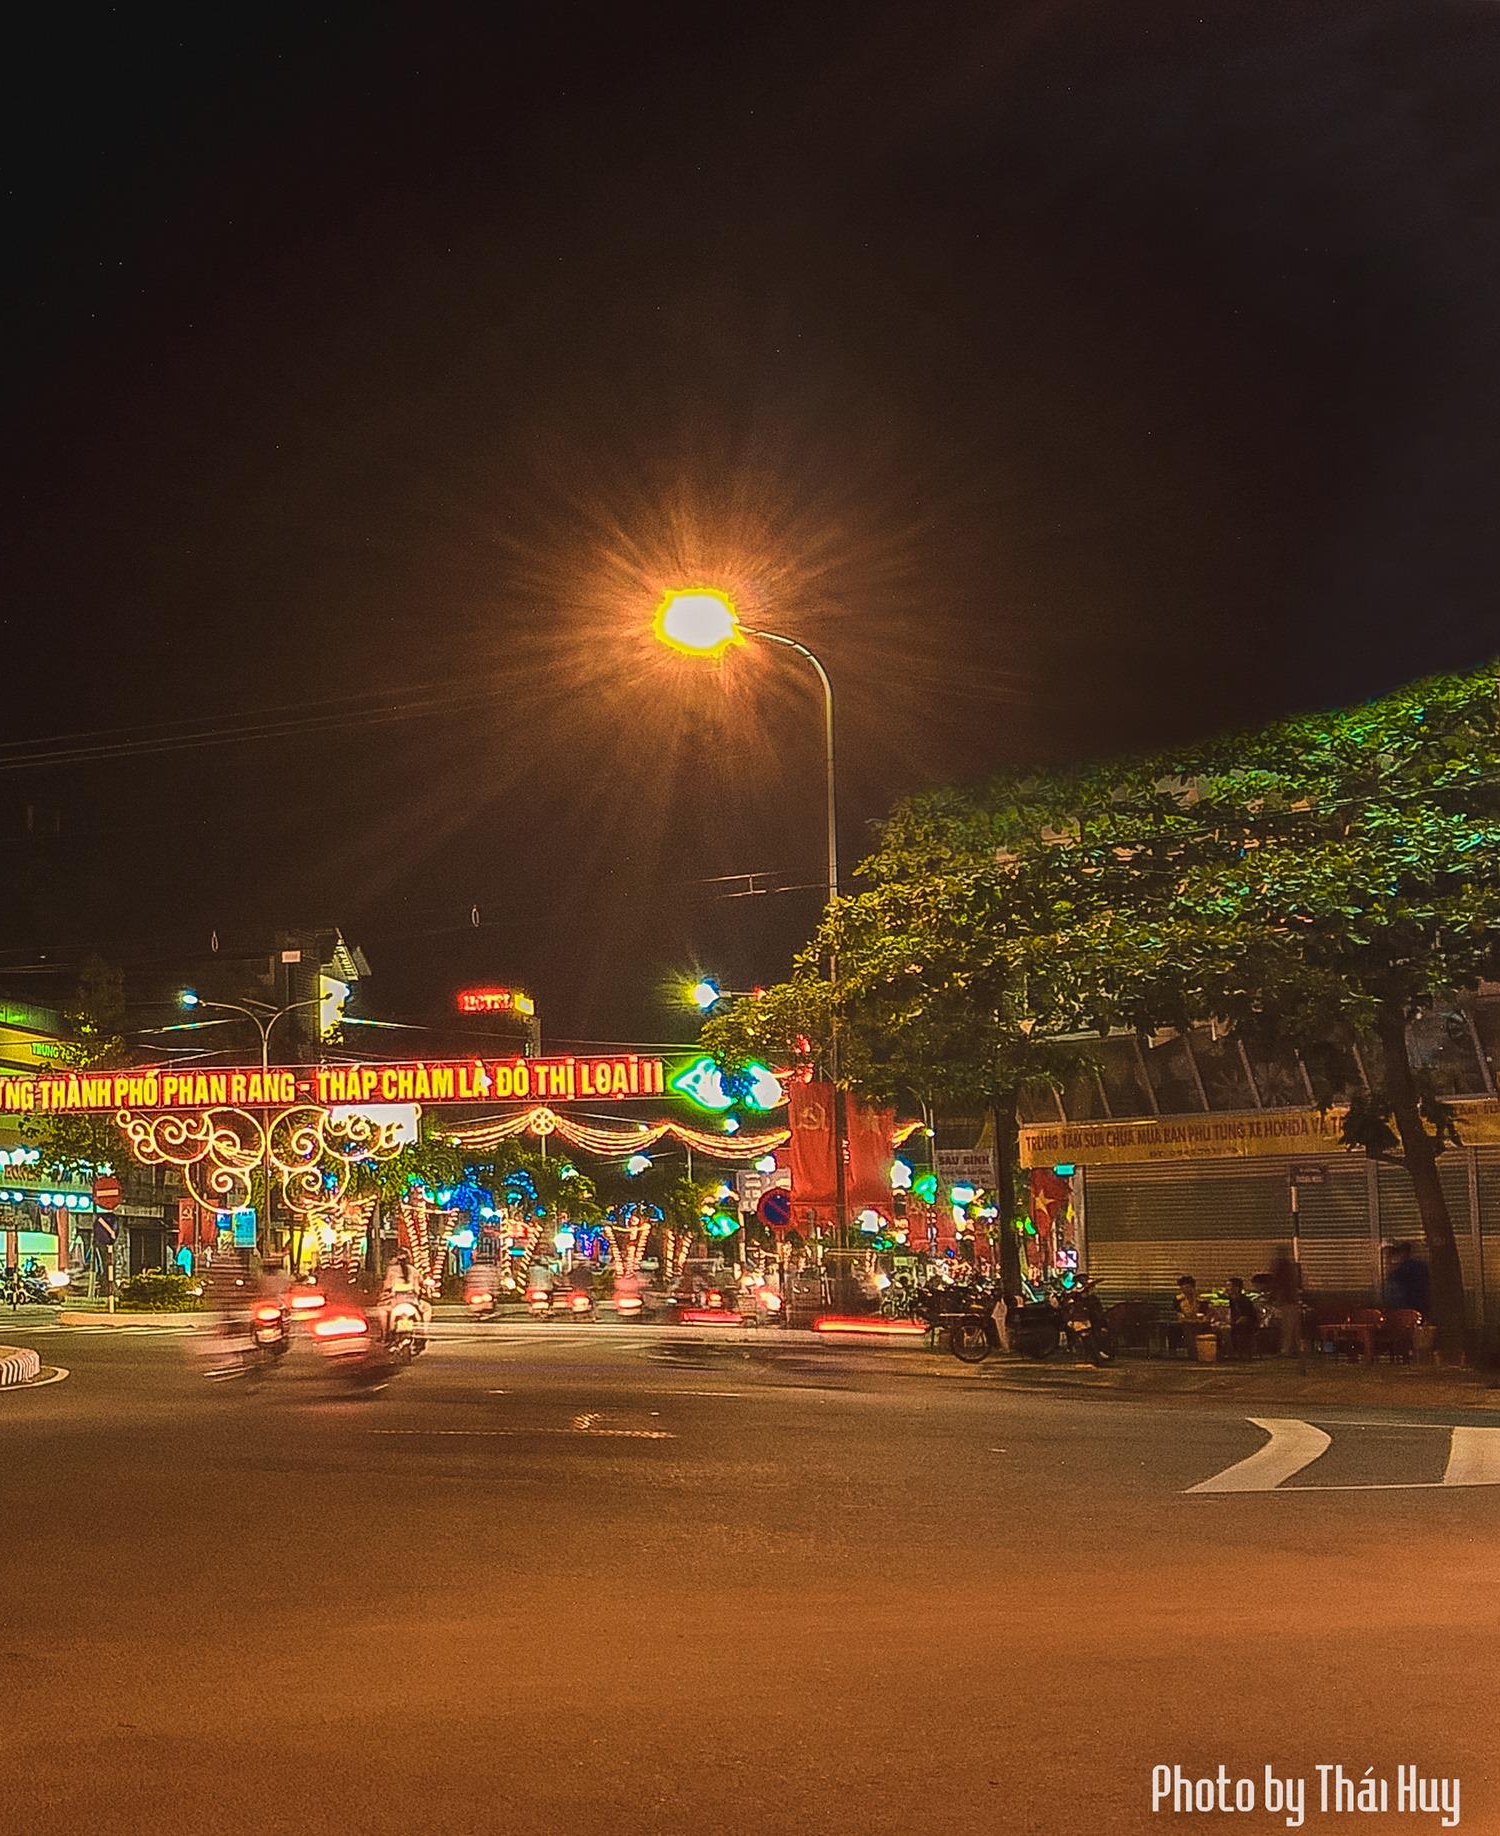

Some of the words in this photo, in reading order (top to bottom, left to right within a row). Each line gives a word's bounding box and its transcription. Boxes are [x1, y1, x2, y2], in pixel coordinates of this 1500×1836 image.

[38, 1073, 111, 1111] THÀNH
[115, 1068, 160, 1107] PHỐ
[163, 1073, 228, 1105] PHAN
[231, 1071, 296, 1103] RANG
[317, 1065, 378, 1100] THÁP
[382, 1062, 455, 1099] CHÀM
[459, 1060, 490, 1097] LÀ
[496, 1059, 531, 1097] ĐÔ
[535, 1057, 576, 1100] THỊ
